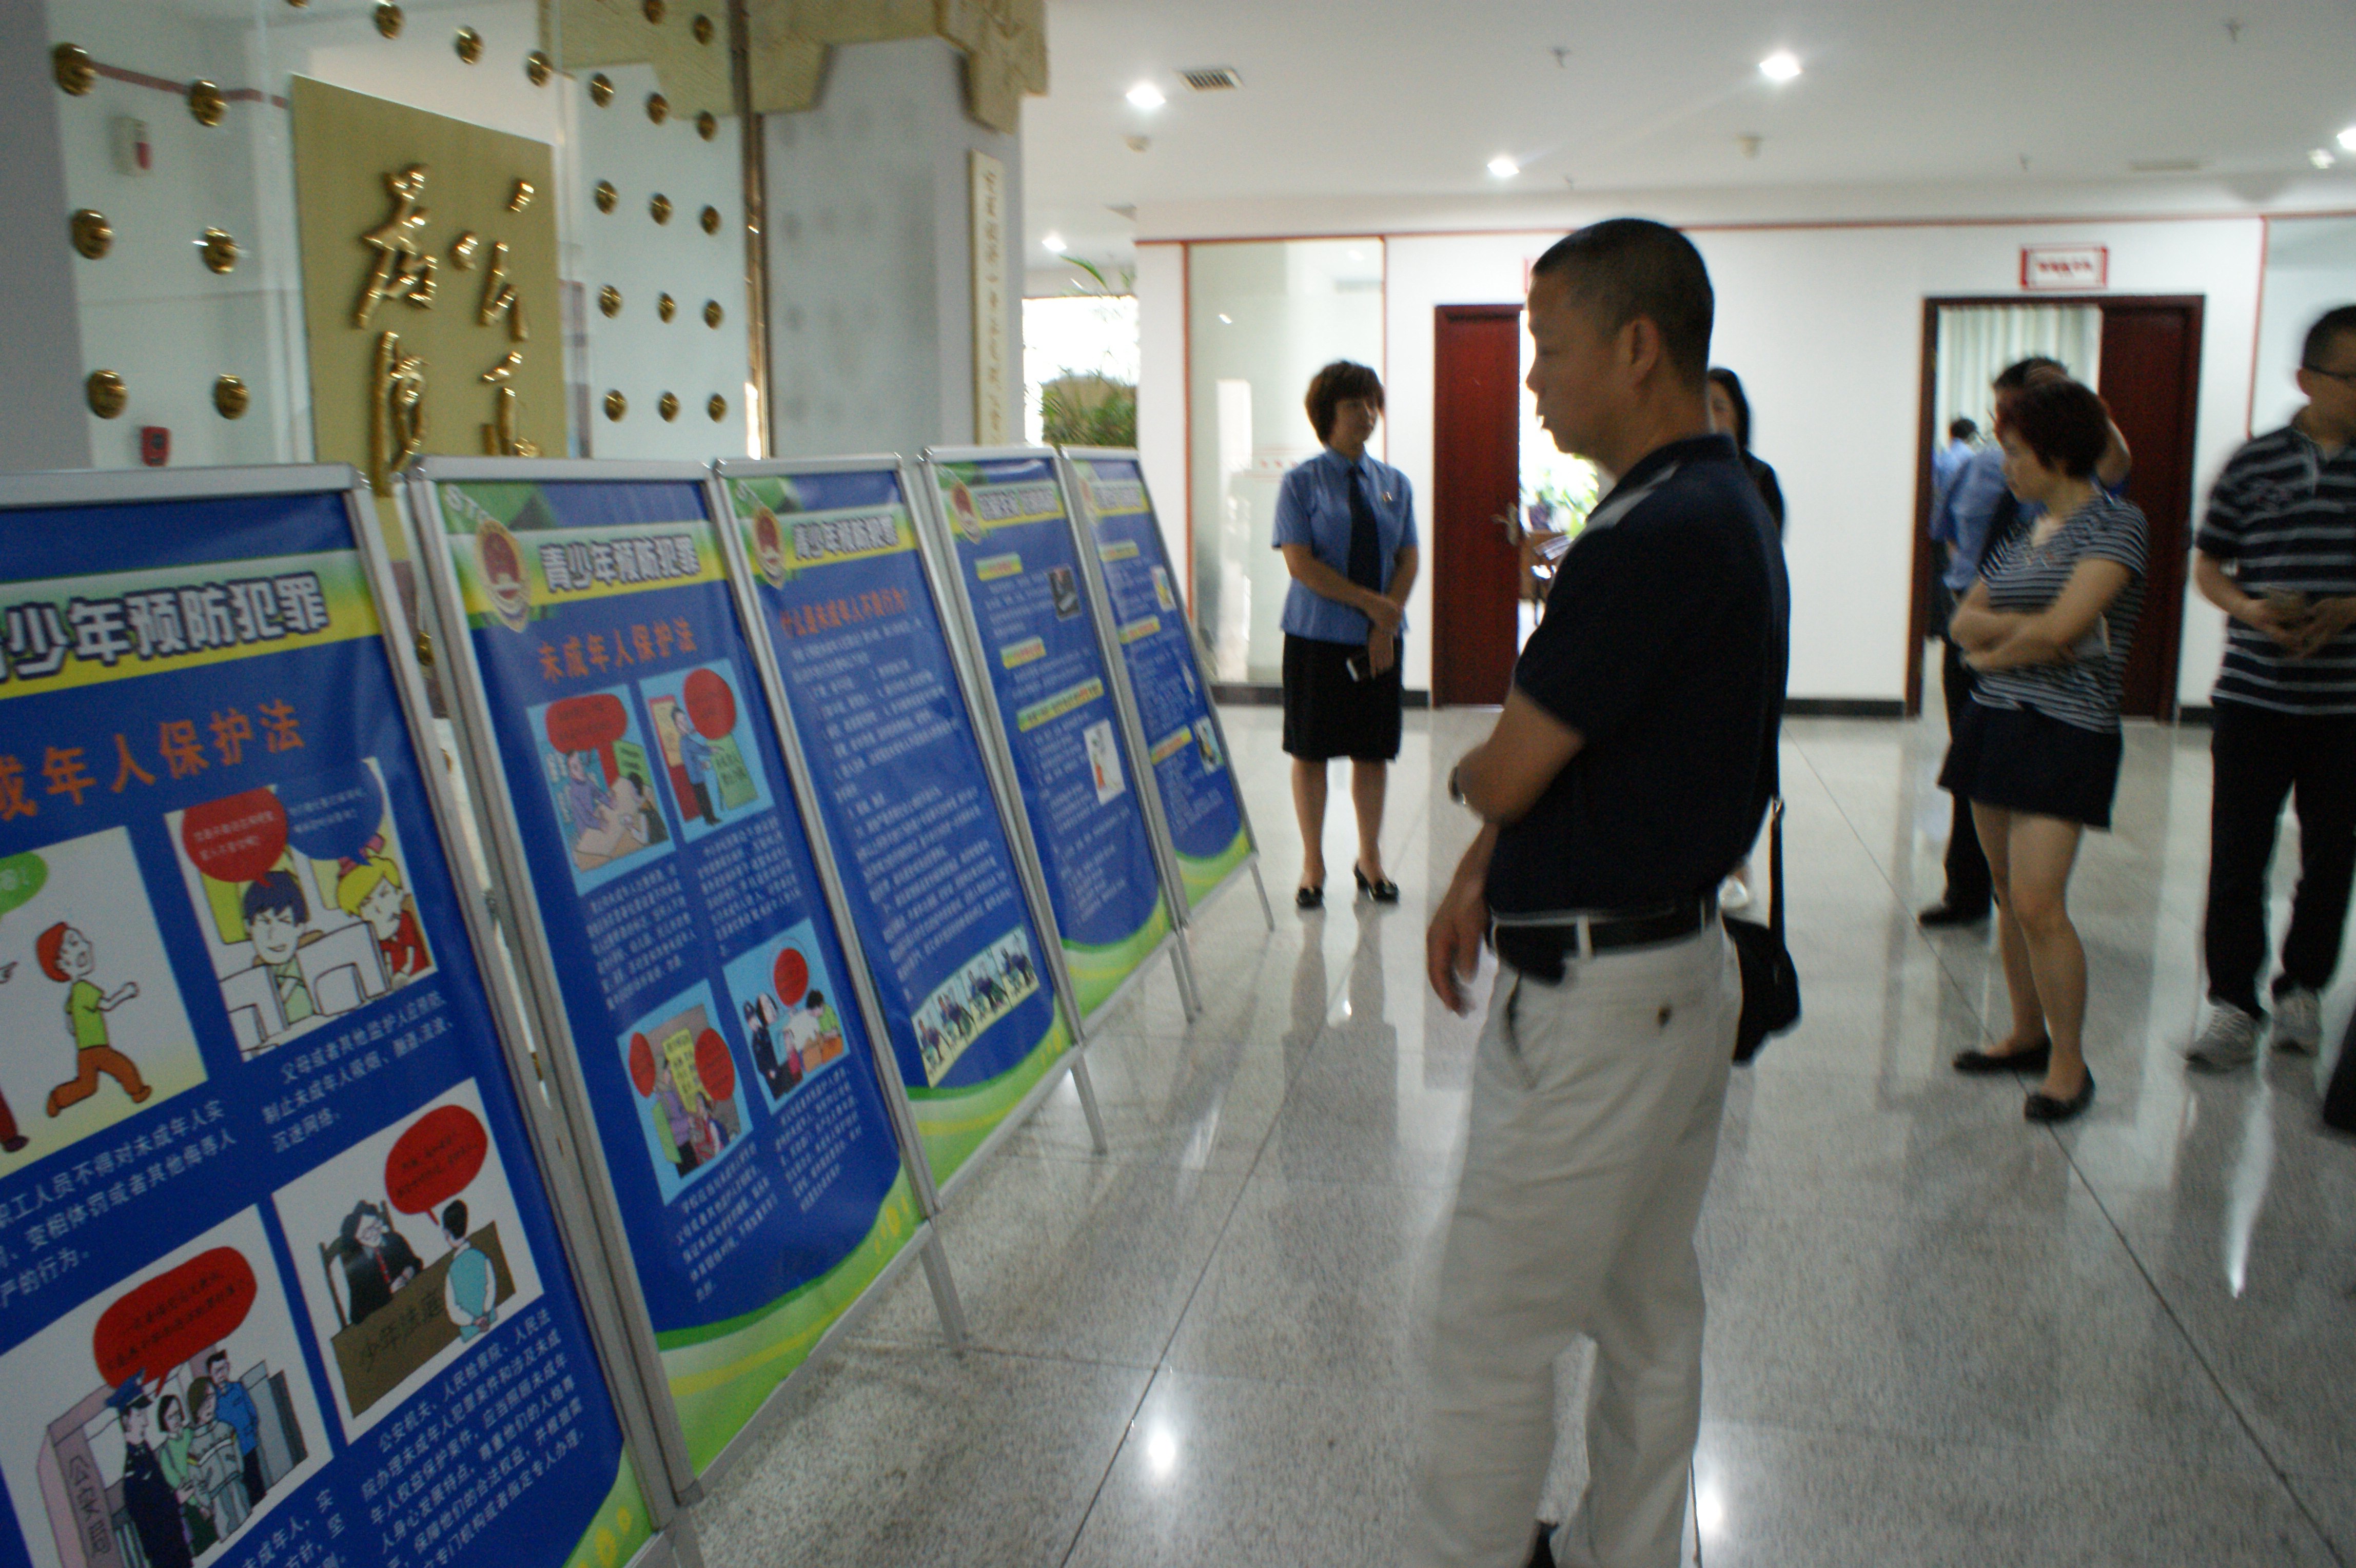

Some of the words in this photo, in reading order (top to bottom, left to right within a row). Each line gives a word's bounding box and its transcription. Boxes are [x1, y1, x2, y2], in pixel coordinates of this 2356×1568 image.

[539, 534, 701, 594] 青少年预防犯罪
[0, 571, 331, 684] 少年预防犯罪
[538, 616, 697, 684] 未成年人保护法
[0, 699, 304, 821] 成年人保护法
